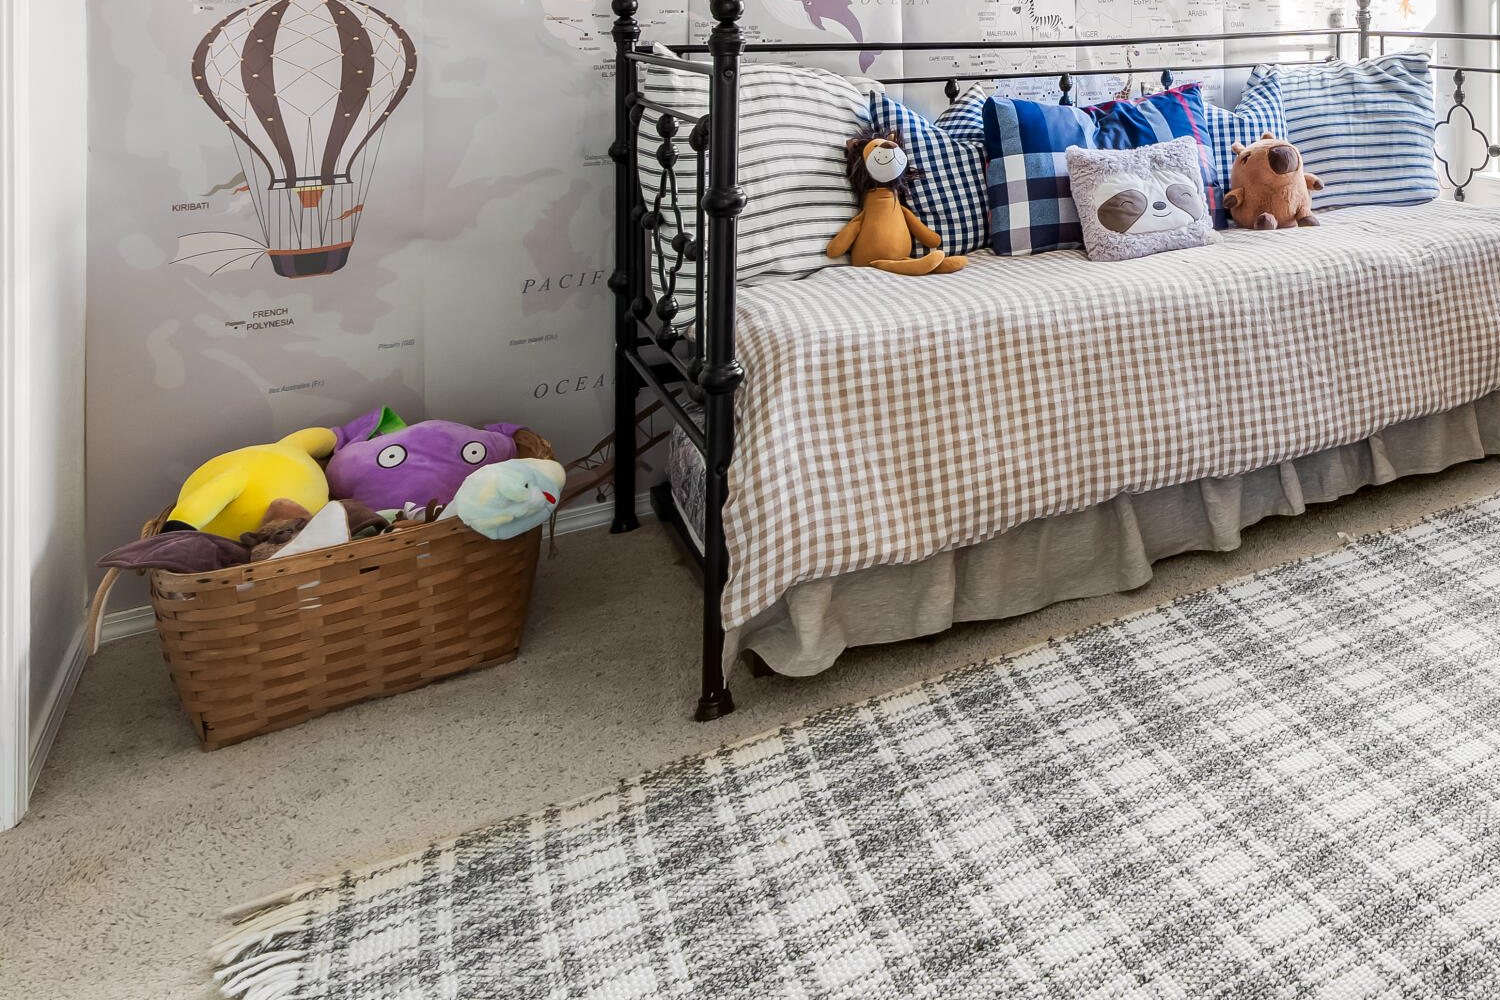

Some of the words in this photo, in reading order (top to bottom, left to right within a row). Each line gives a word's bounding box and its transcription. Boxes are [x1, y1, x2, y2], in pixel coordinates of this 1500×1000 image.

[172, 202, 209, 212] KIRIBATI
[521, 270, 605, 294] PACIF
[253, 307, 288, 319] FRENCH
[246, 318, 294, 331] POLYNESIA
[533, 373, 616, 399] OCEA
